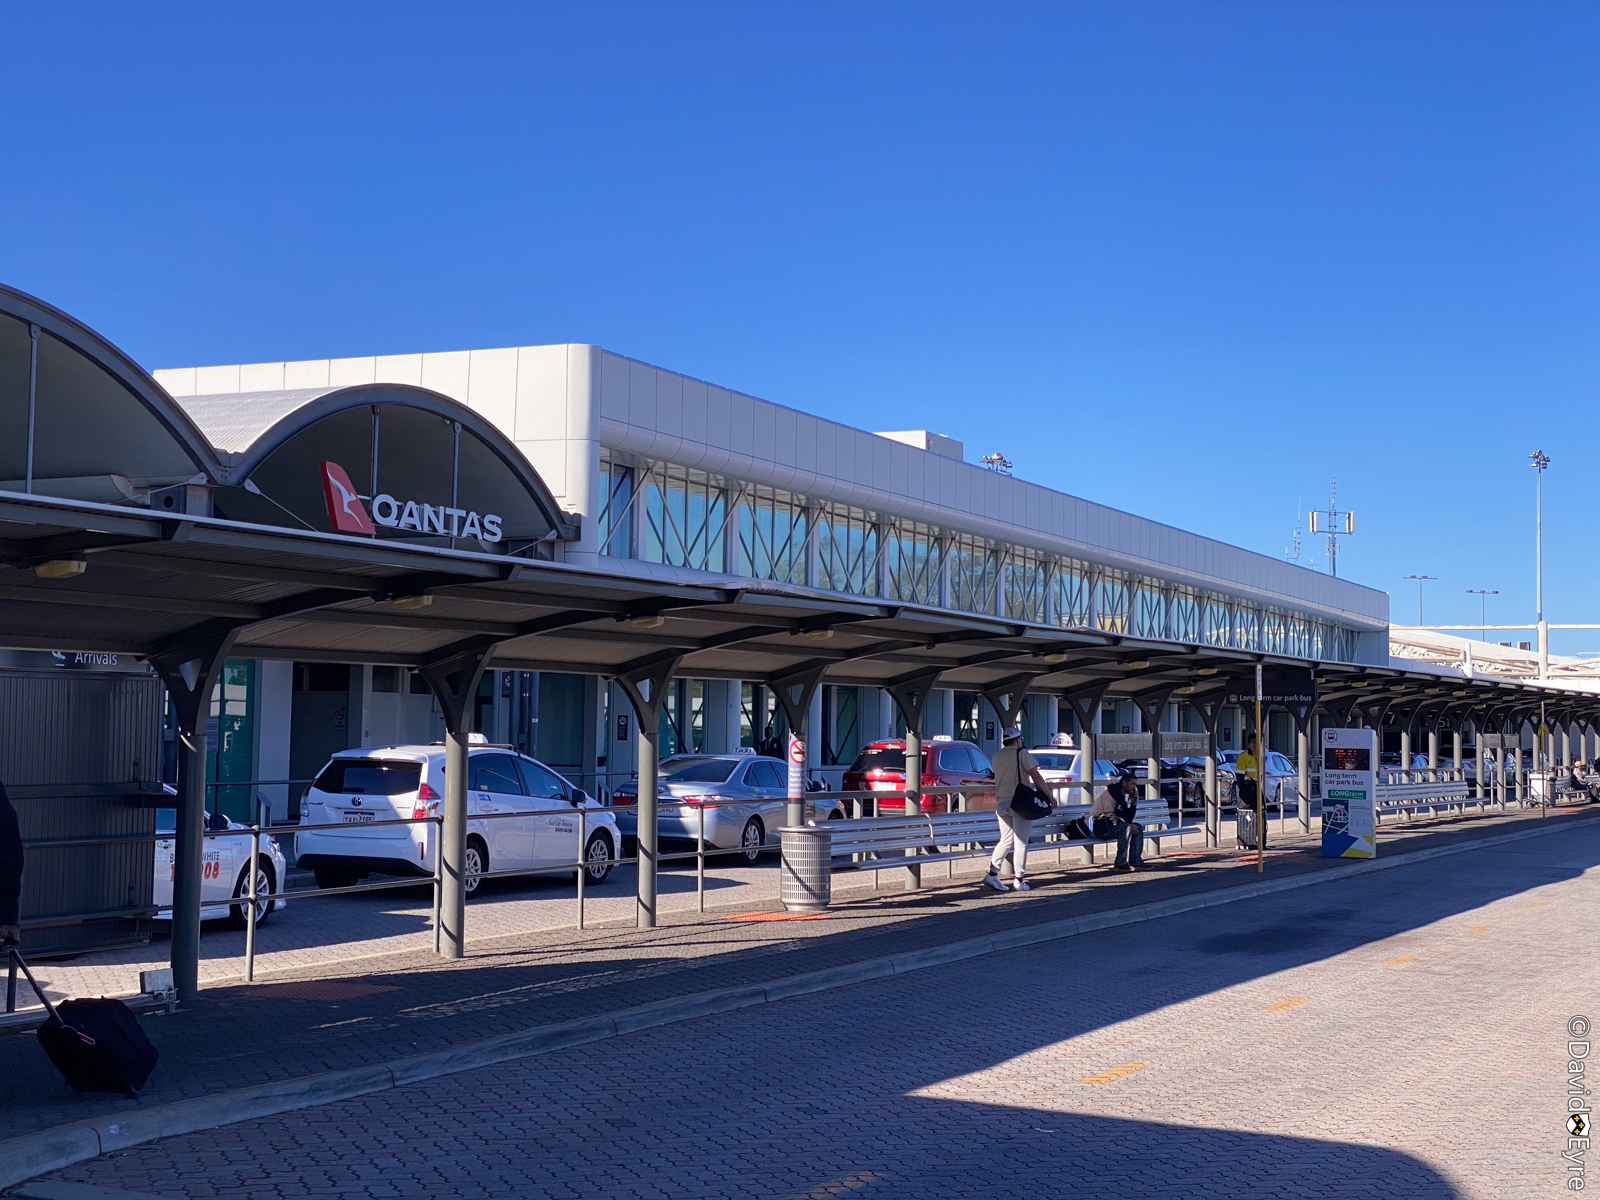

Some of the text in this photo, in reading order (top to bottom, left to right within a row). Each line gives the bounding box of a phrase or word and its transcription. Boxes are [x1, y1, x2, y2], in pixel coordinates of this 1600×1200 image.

[372, 494, 503, 543] QANTAS
[74, 652, 118, 666] Arrivals
[1240, 694, 1256, 703] Long
[1284, 694, 1299, 703] park
[1164, 740, 1174, 753] Long
